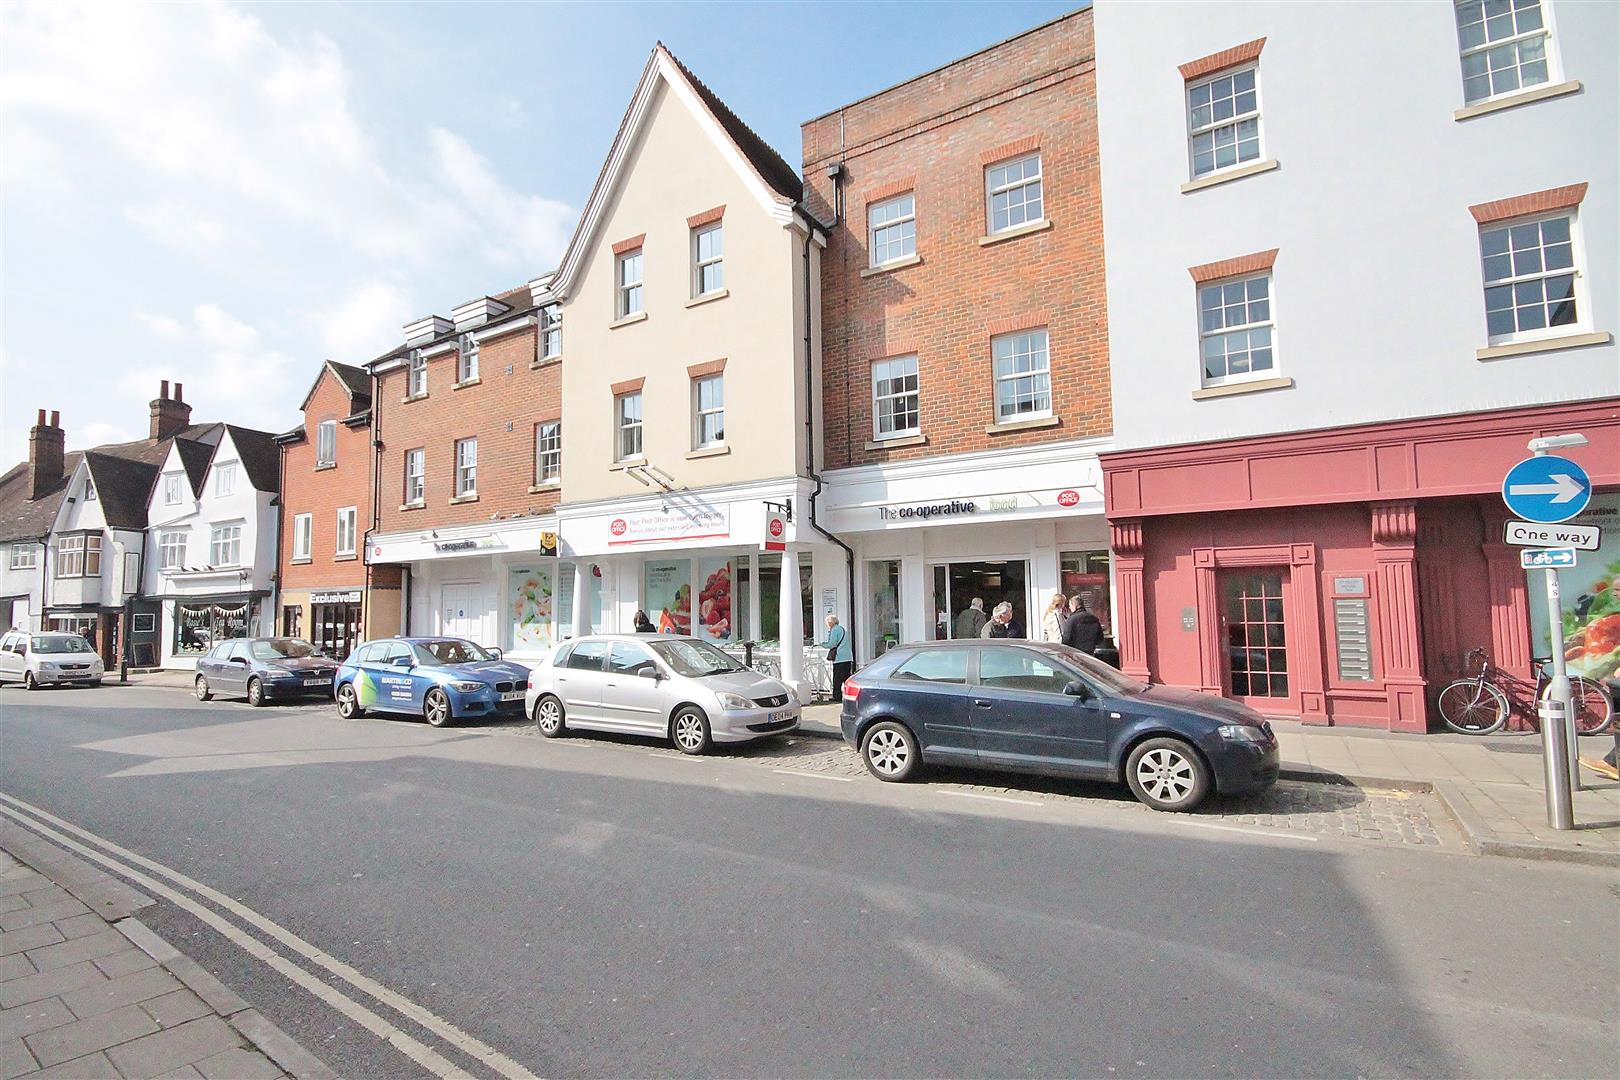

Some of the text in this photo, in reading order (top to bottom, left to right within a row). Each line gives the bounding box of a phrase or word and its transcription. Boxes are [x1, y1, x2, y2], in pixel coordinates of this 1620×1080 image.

[879, 496, 1017, 520] The co-operative food
[641, 517, 653, 525] Post
[1514, 528, 1591, 545] One way
[310, 592, 350, 604] Exclusive
